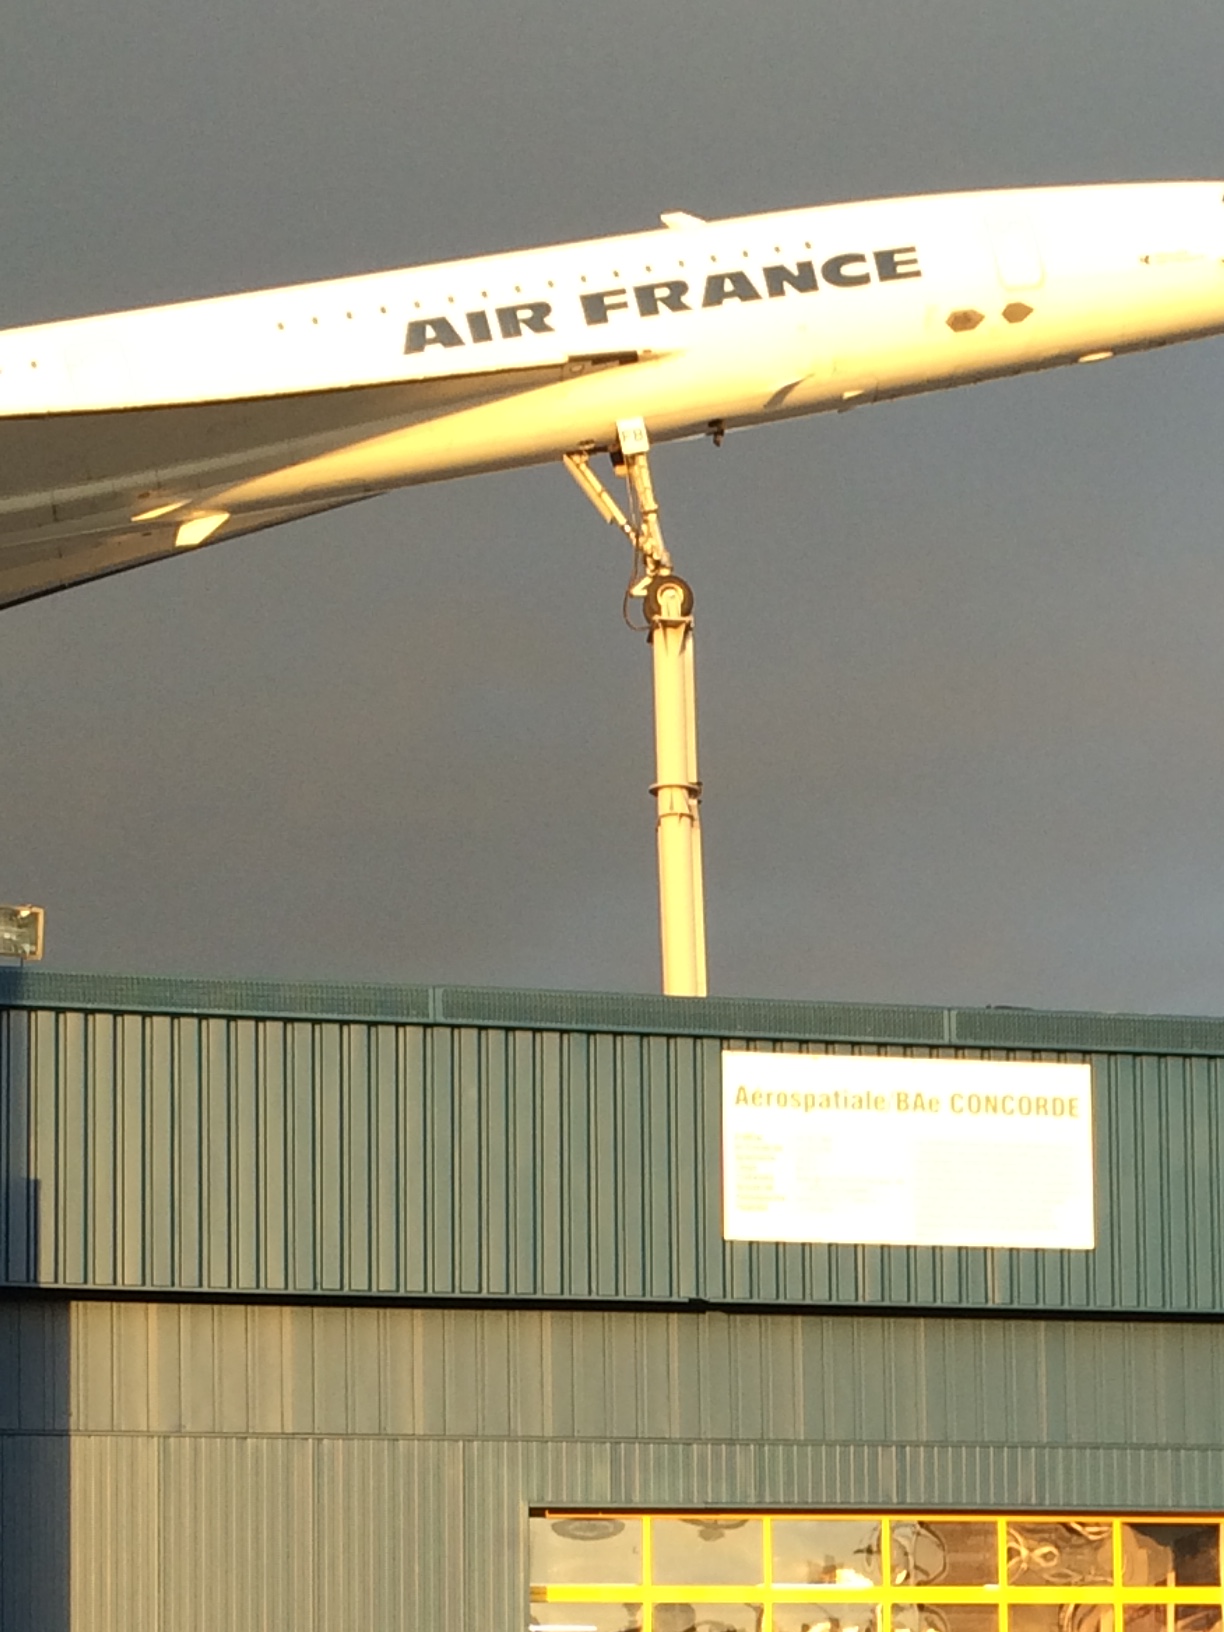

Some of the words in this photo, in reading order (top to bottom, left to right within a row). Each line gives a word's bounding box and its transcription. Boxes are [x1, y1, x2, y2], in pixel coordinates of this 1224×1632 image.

[404, 301, 554, 354] AIR
[580, 246, 922, 325] FRANCE
[950, 1094, 1079, 1118] CONCORDE
